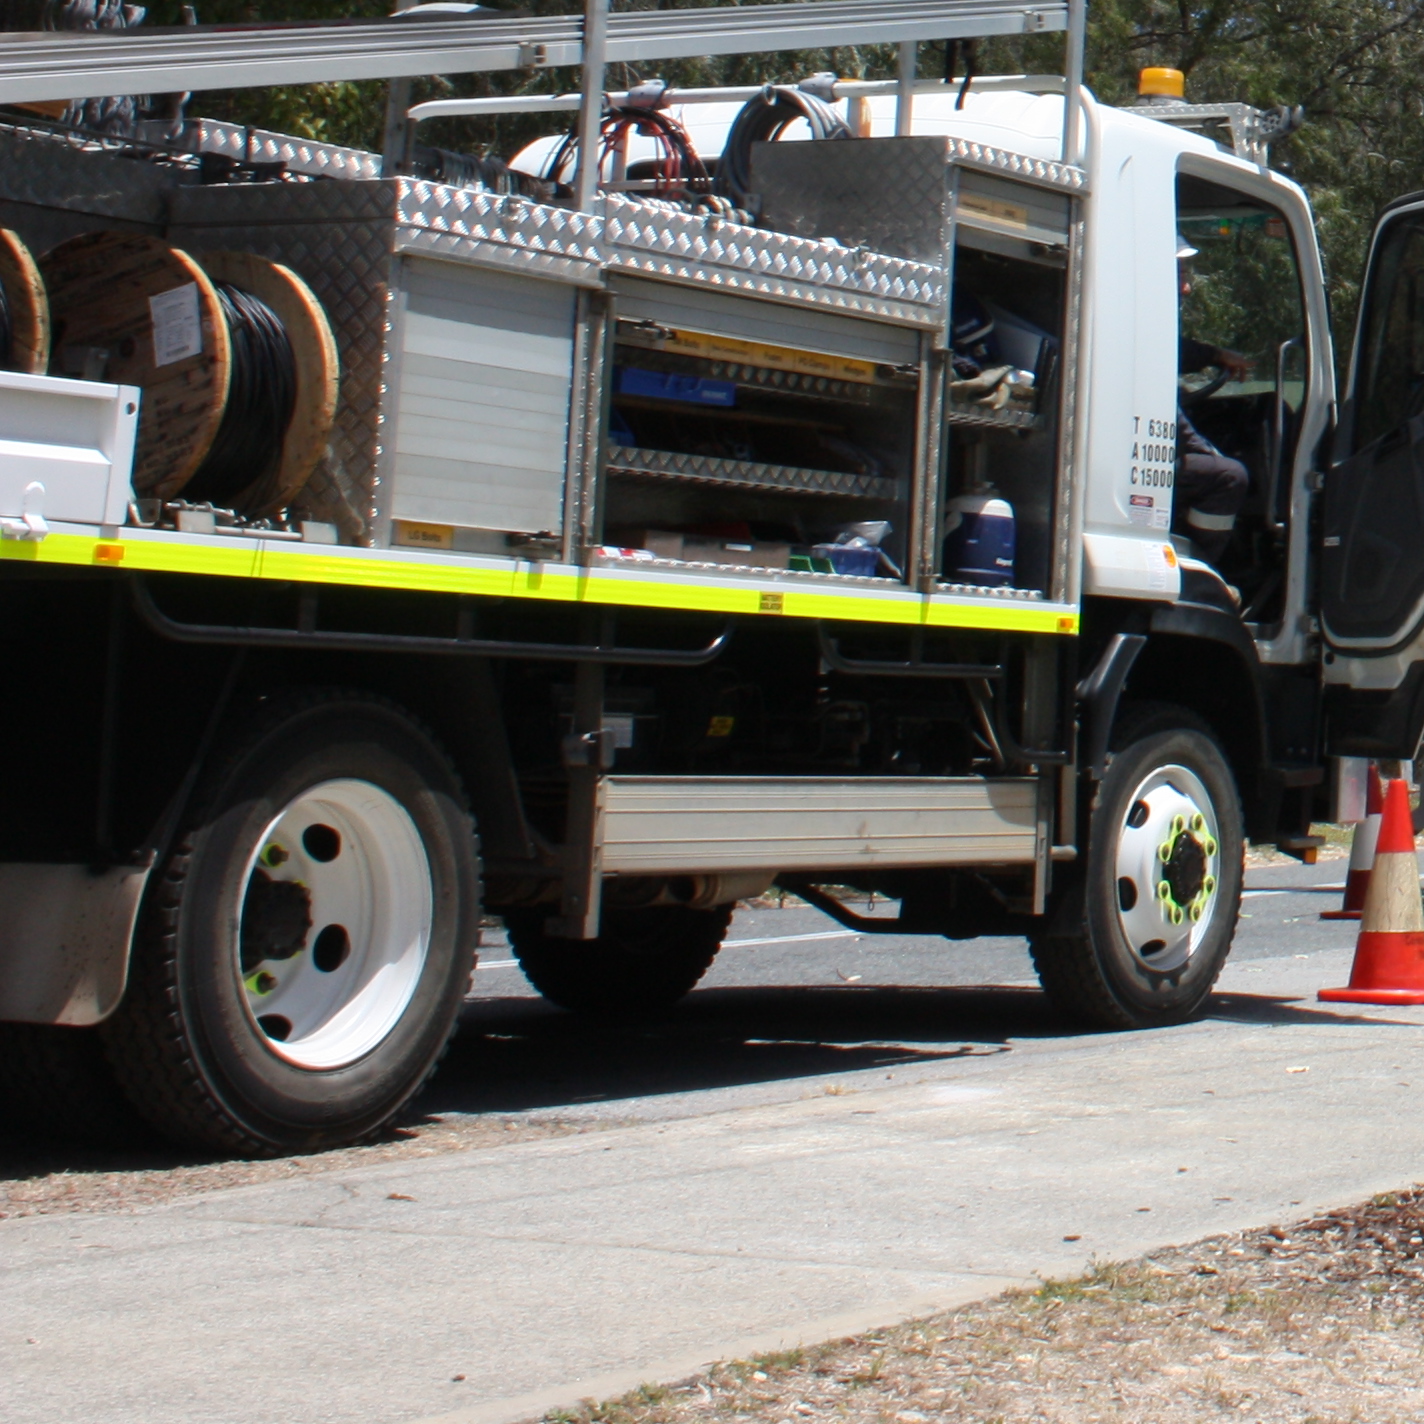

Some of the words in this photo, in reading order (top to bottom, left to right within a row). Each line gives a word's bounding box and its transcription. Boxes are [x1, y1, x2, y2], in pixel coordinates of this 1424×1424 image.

[1133, 416, 1140, 434] T
[1148, 419, 1175, 440] 6380
[1131, 442, 1139, 461] A
[1142, 444, 1175, 464] 10000
[1130, 466, 1138, 485] C
[1140, 468, 1174, 489] 15000
